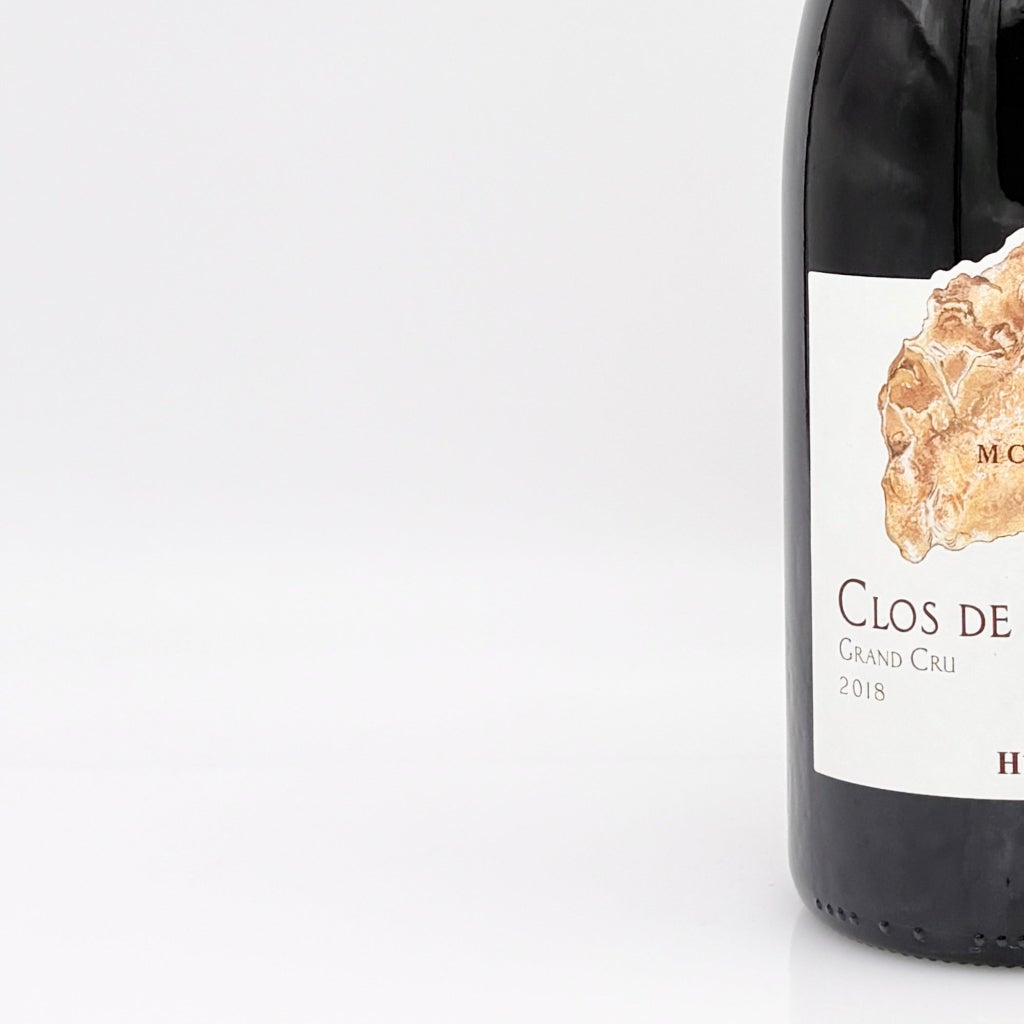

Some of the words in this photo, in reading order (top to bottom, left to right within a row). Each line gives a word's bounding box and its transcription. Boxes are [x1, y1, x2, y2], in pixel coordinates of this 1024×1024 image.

[838, 578, 940, 635] CLOS
[959, 603, 1012, 638] DE
[839, 637, 903, 669] GRAND
[910, 647, 956, 674] CRU
[839, 676, 886, 702] 2018
